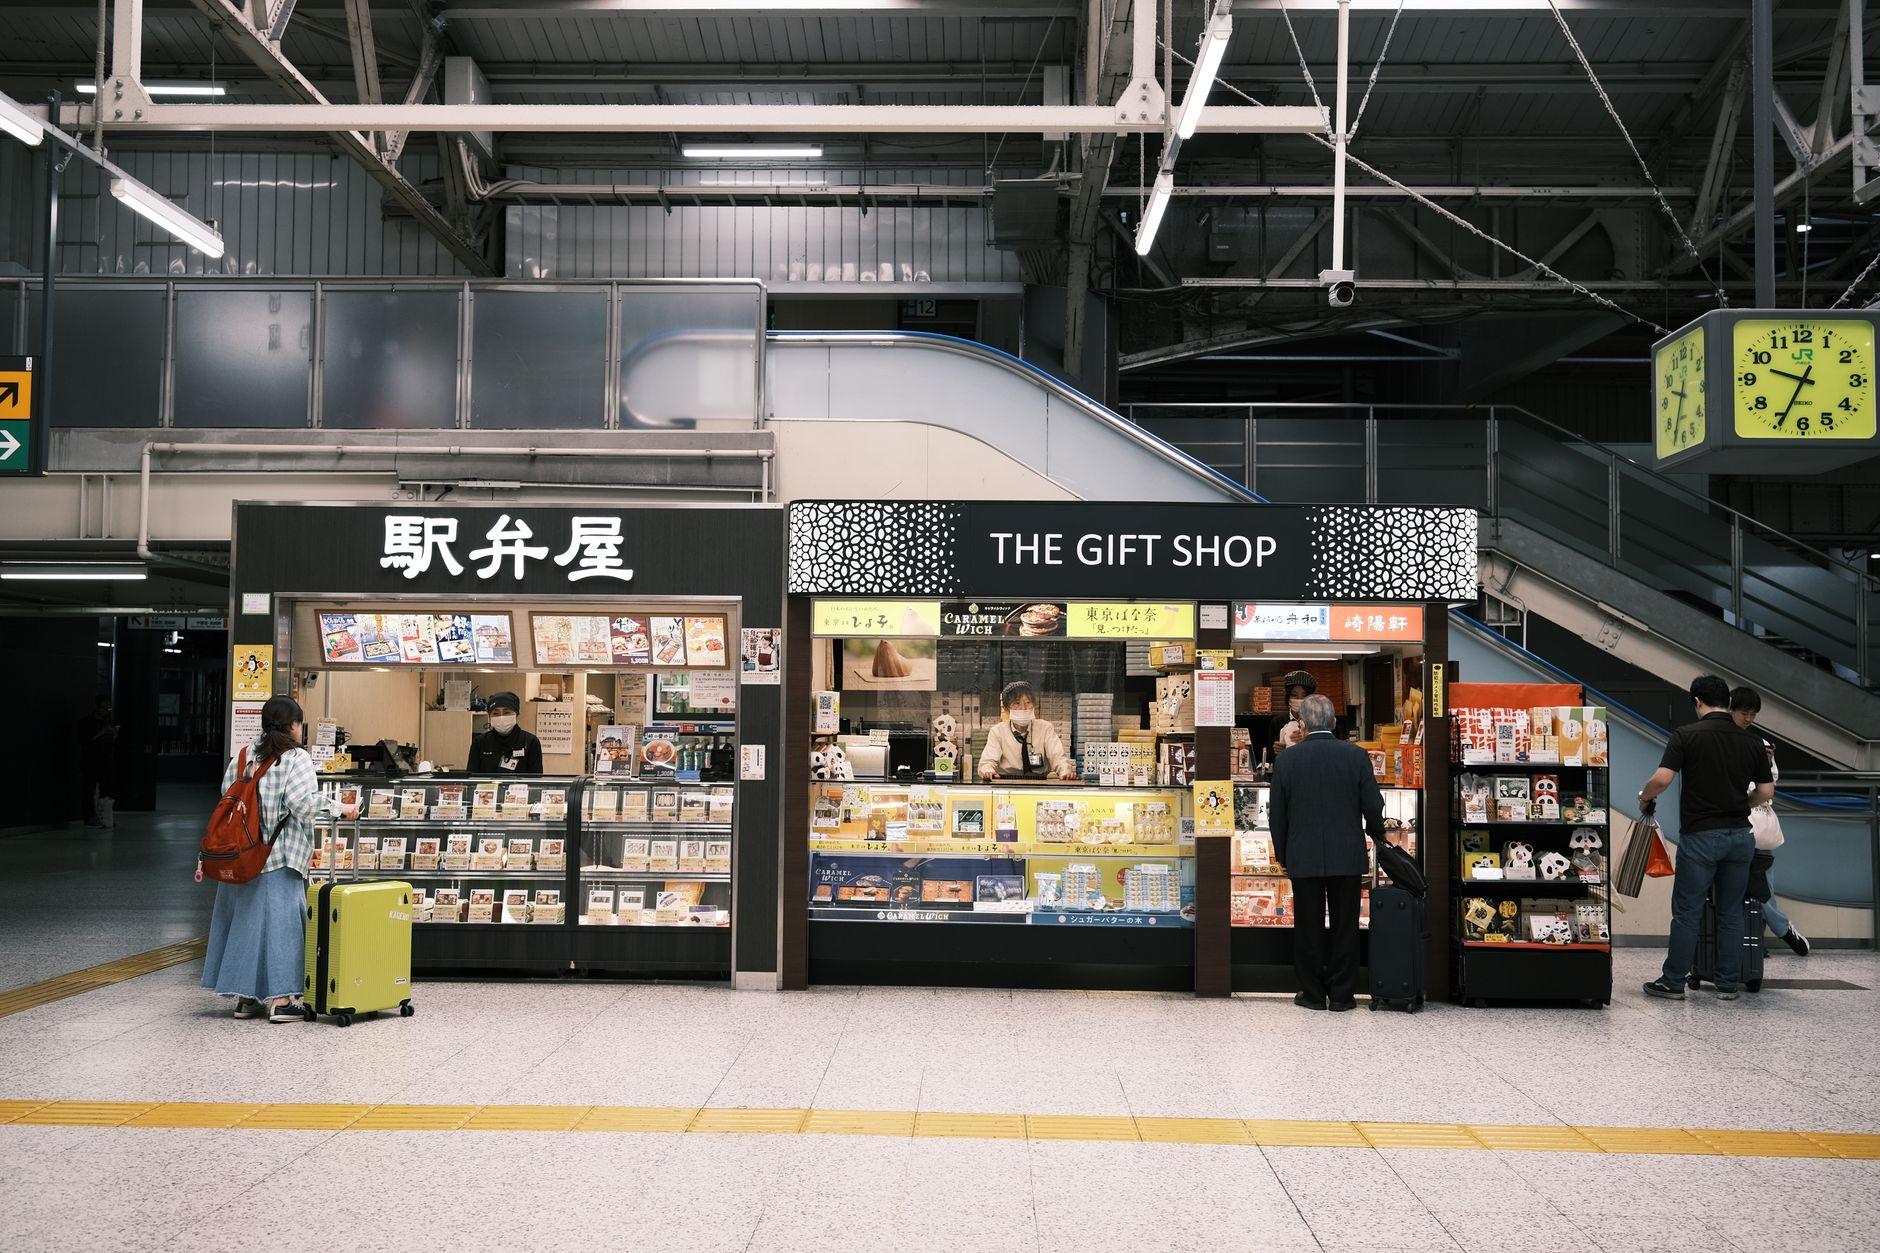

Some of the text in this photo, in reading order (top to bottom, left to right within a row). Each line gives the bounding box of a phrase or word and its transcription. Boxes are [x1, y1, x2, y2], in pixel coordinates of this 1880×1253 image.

[1771, 336, 1788, 349] 11
[1792, 330, 1813, 343] 12
[1822, 336, 1830, 348] 1
[1752, 351, 1772, 364] 10
[1792, 348, 1813, 360] JR
[1839, 350, 1852, 363] 2
[1743, 373, 1757, 386] 9
[1849, 374, 1862, 387] 3
[1754, 396, 1768, 410] 8
[1838, 397, 1852, 411] 4
[1796, 417, 1809, 430] 6
[1820, 412, 1833, 426] 5
[380, 514, 634, 582] 駅弁屋
[990, 533, 1277, 568] THE GIFT SHOP
[944, 612, 1005, 624] CARAMEL
[1086, 607, 1157, 622] 東京ばな奈
[1287, 612, 1318, 625] 舟和
[956, 623, 993, 635] WICH
[1344, 614, 1408, 633] 崎陽軒
[815, 868, 852, 876] CARAMEL
[1070, 915, 1143, 925] シュガーバターの木
